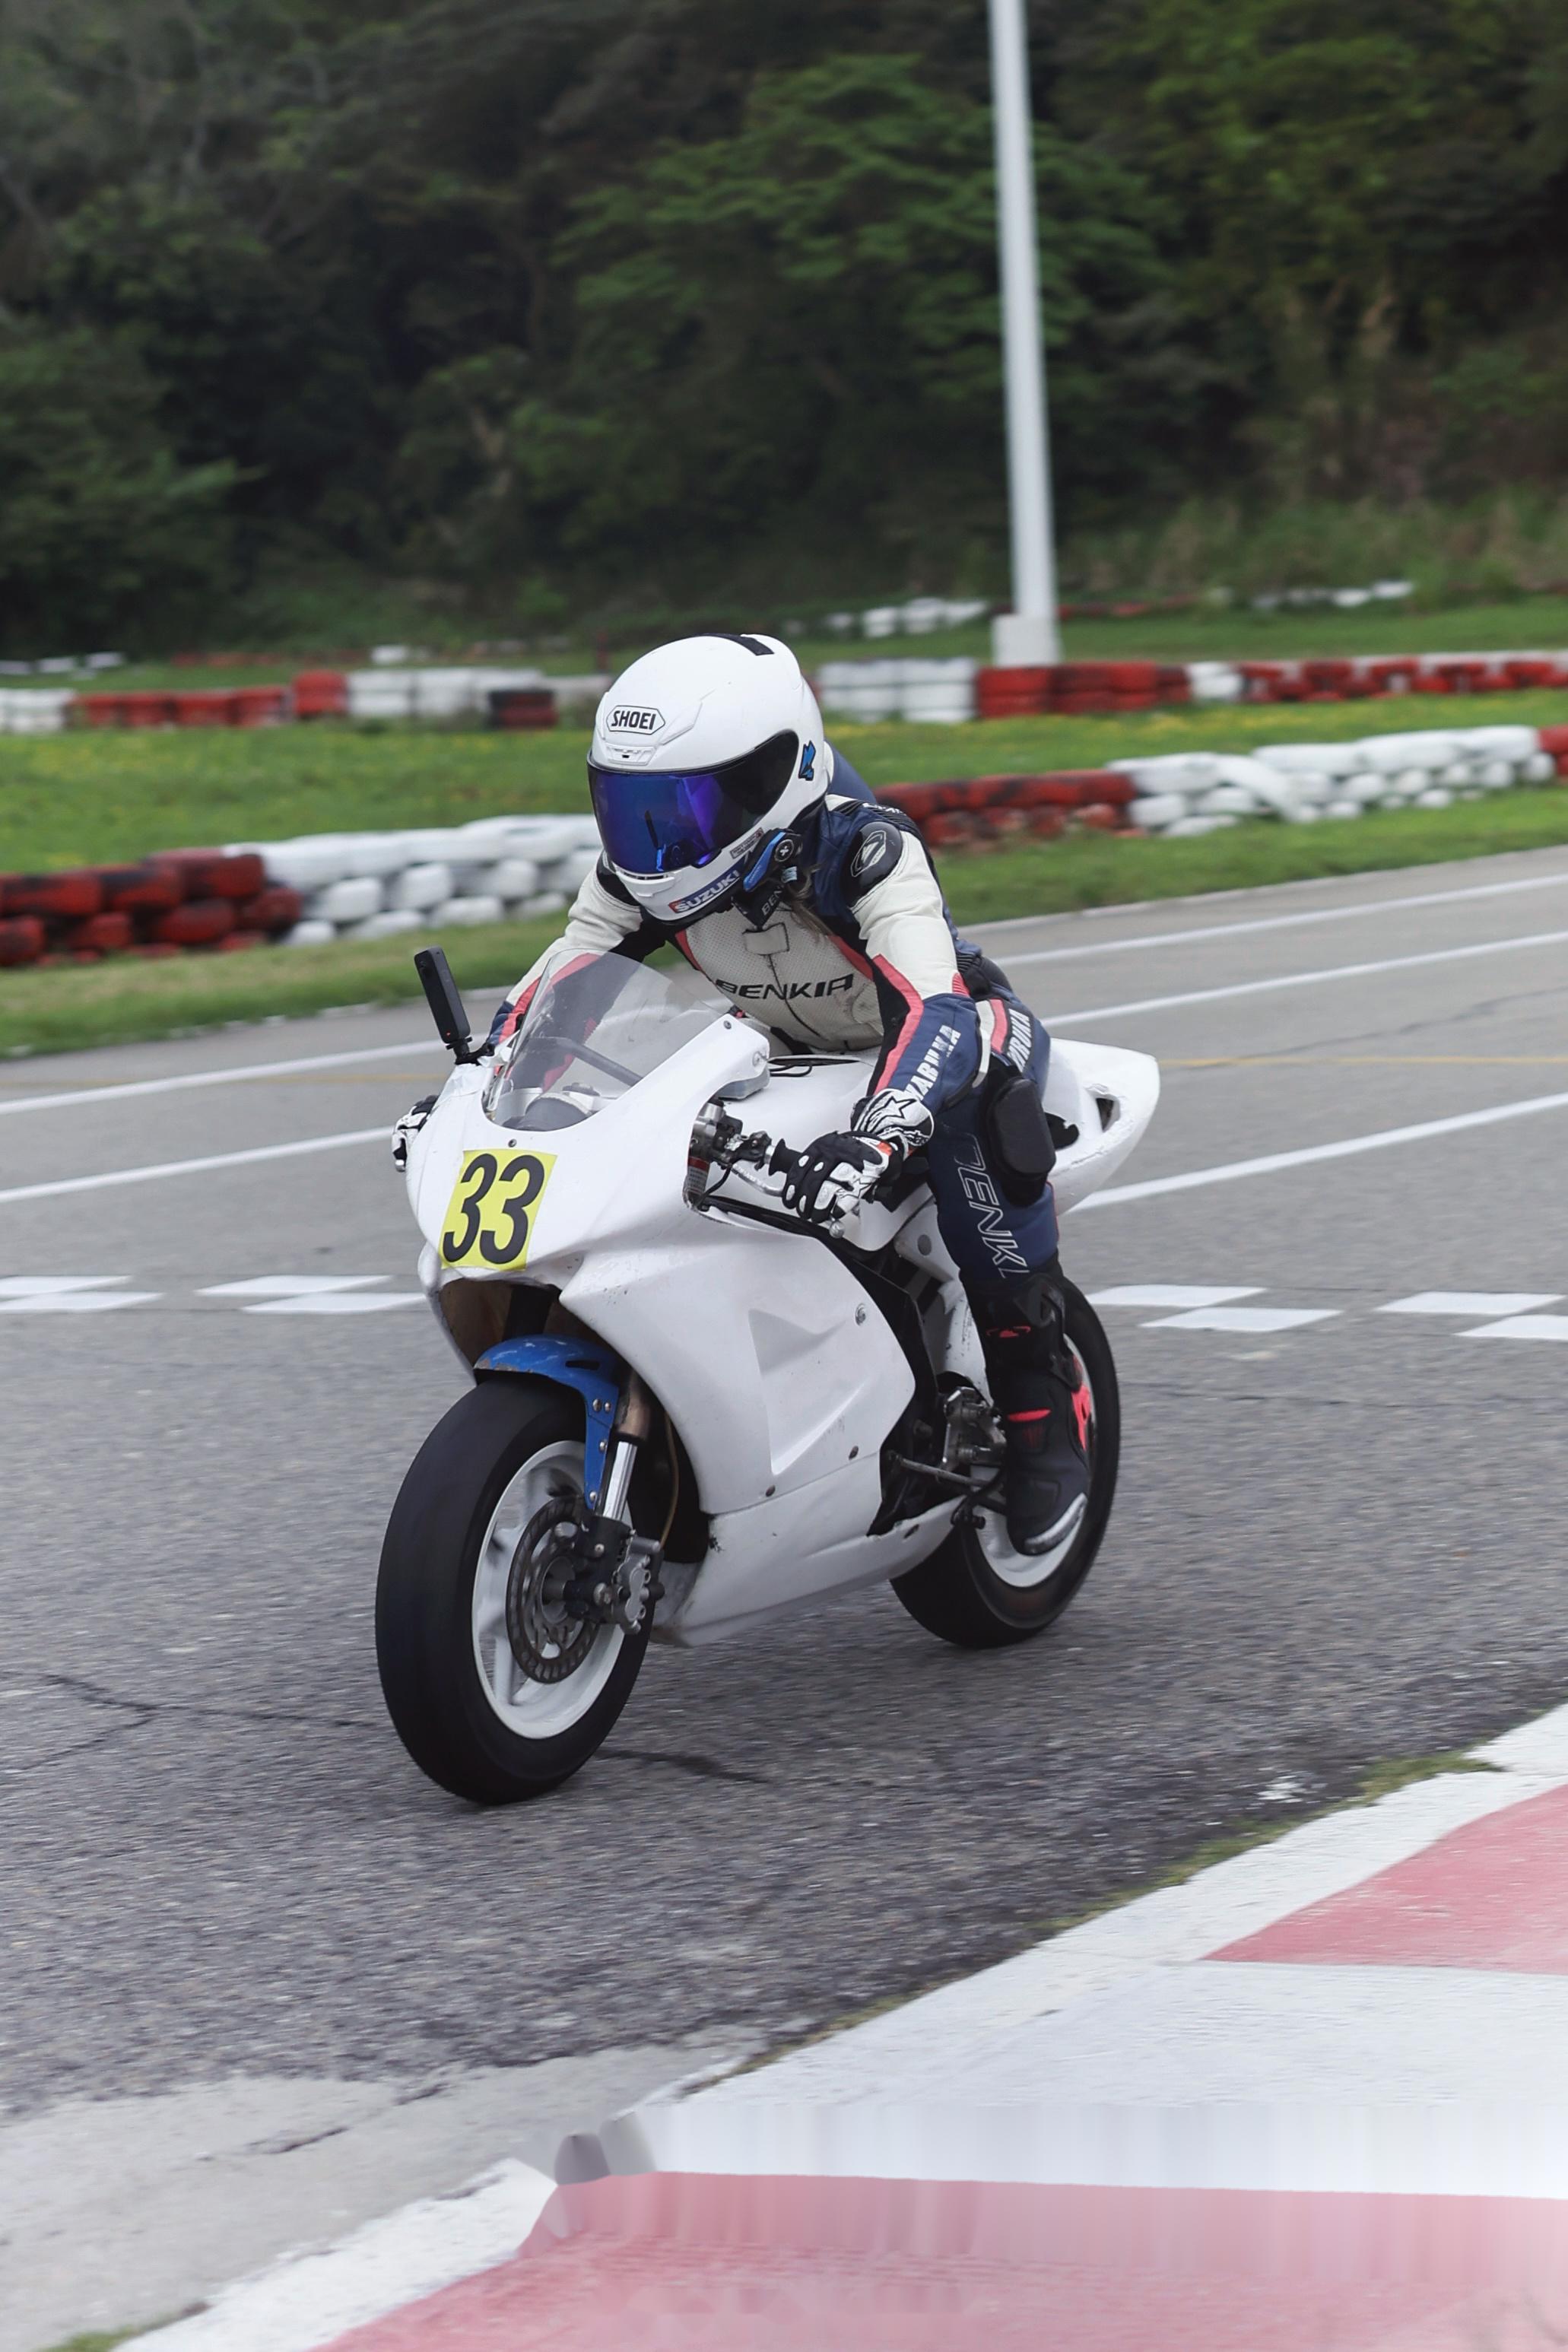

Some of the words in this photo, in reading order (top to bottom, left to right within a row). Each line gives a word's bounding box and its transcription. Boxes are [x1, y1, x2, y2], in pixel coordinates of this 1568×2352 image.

[611, 709, 657, 730] SHOEI
[674, 869, 741, 913] SUZUKI
[715, 973, 854, 1001] BENKIA
[442, 1153, 545, 1265] 33
